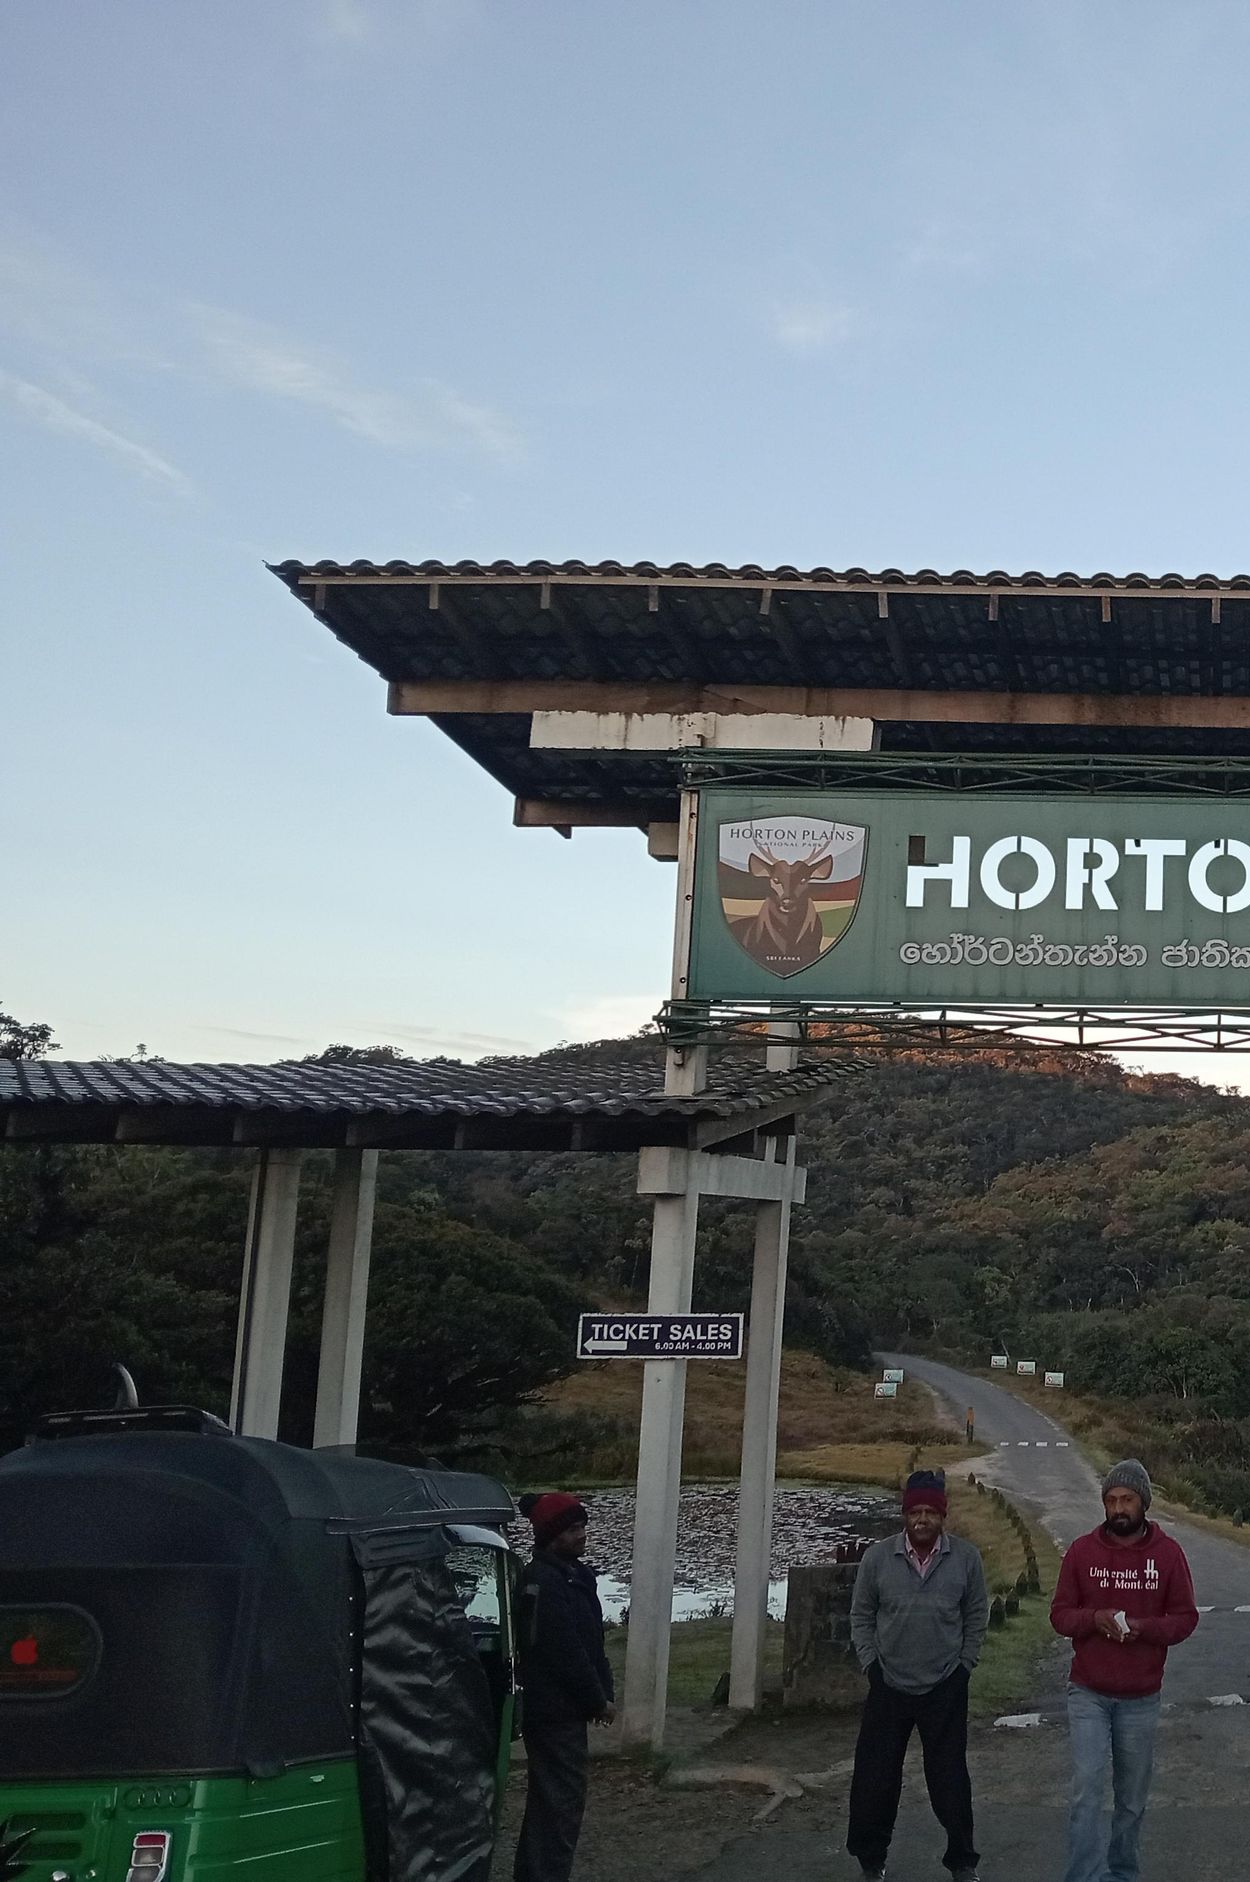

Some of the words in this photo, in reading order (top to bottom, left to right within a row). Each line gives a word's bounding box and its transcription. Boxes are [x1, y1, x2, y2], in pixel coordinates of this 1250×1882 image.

[730, 828, 797, 840] HORTON
[802, 829, 855, 842] PLAINS
[591, 1323, 663, 1341] TICKET
[669, 1323, 733, 1341] SALES
[674, 1341, 690, 1350] AM
[696, 1341, 716, 1350] 4.00
[717, 1341, 732, 1350] PM
[1114, 1579, 1159, 1590] Montéal
